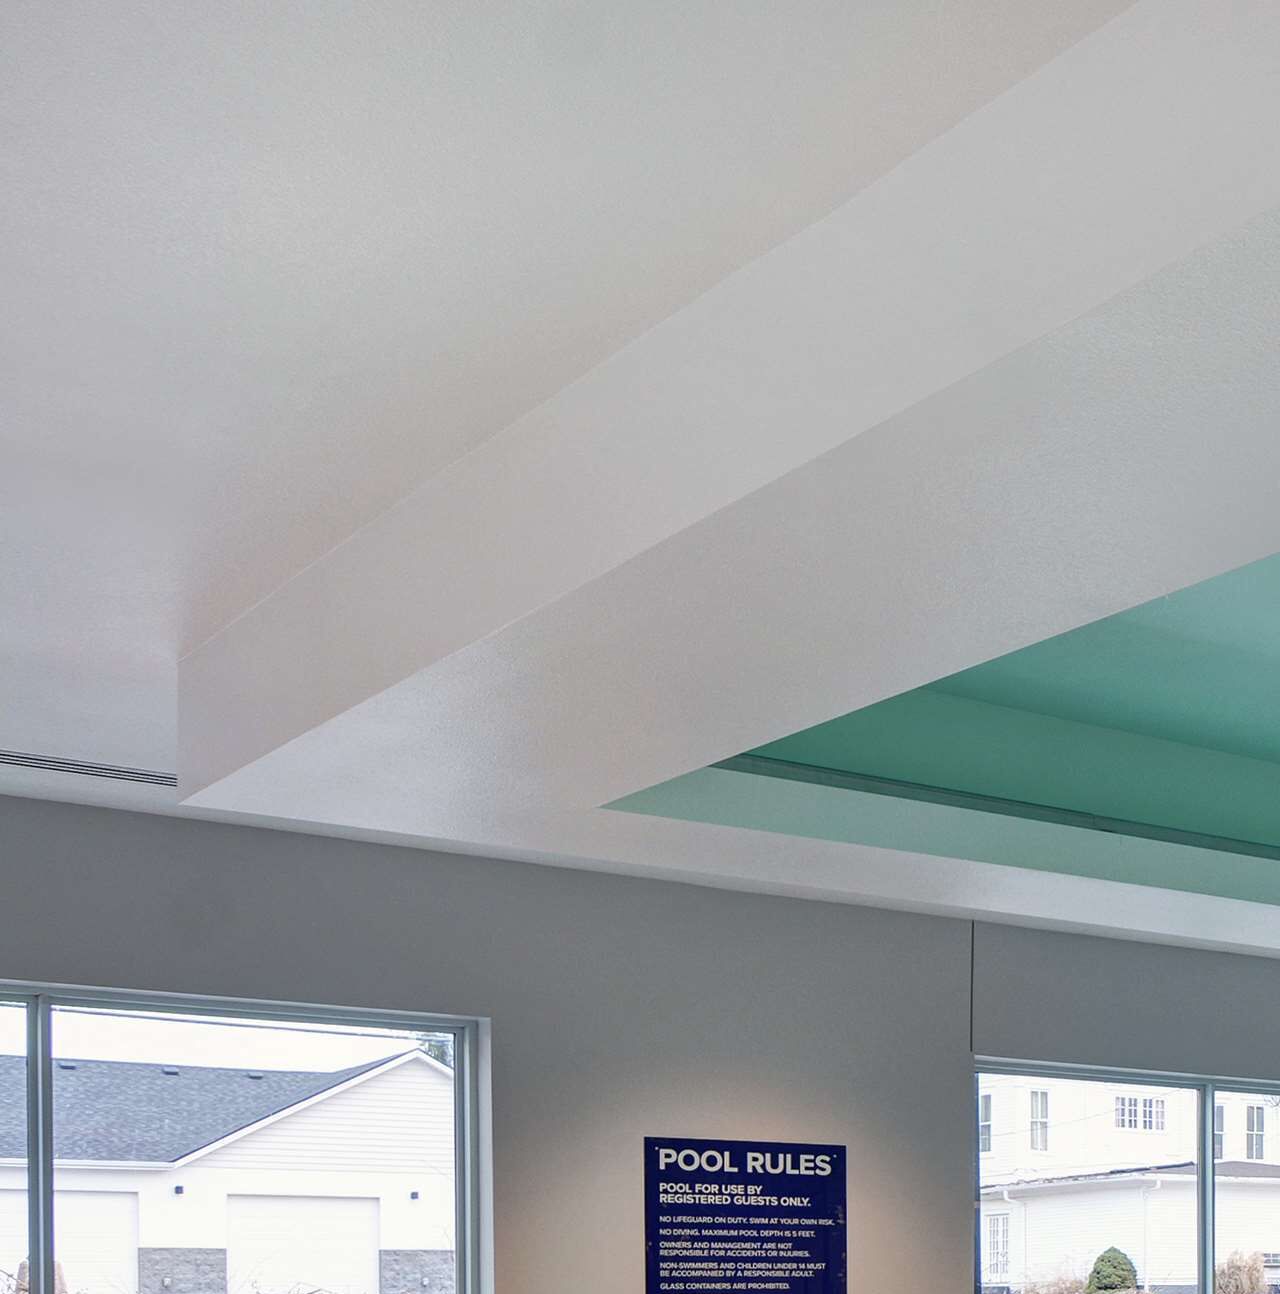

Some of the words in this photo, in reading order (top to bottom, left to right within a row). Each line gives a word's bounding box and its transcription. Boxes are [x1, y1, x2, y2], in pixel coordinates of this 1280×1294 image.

[659, 1148, 738, 1173] POOL
[746, 1152, 831, 1176] RULES
[659, 1183, 692, 1193] POOL
[694, 1184, 719, 1194] FOR
[721, 1184, 745, 1194] USE
[746, 1185, 762, 1194] BY
[659, 1194, 731, 1205] REGISTERED
[733, 1196, 778, 1206] GUESTS
[780, 1197, 811, 1207] ONLY.
[672, 1216, 713, 1224] LIFEGUARD
[749, 1217, 769, 1225] SWIM
[701, 1229, 738, 1237] MAXIMUM
